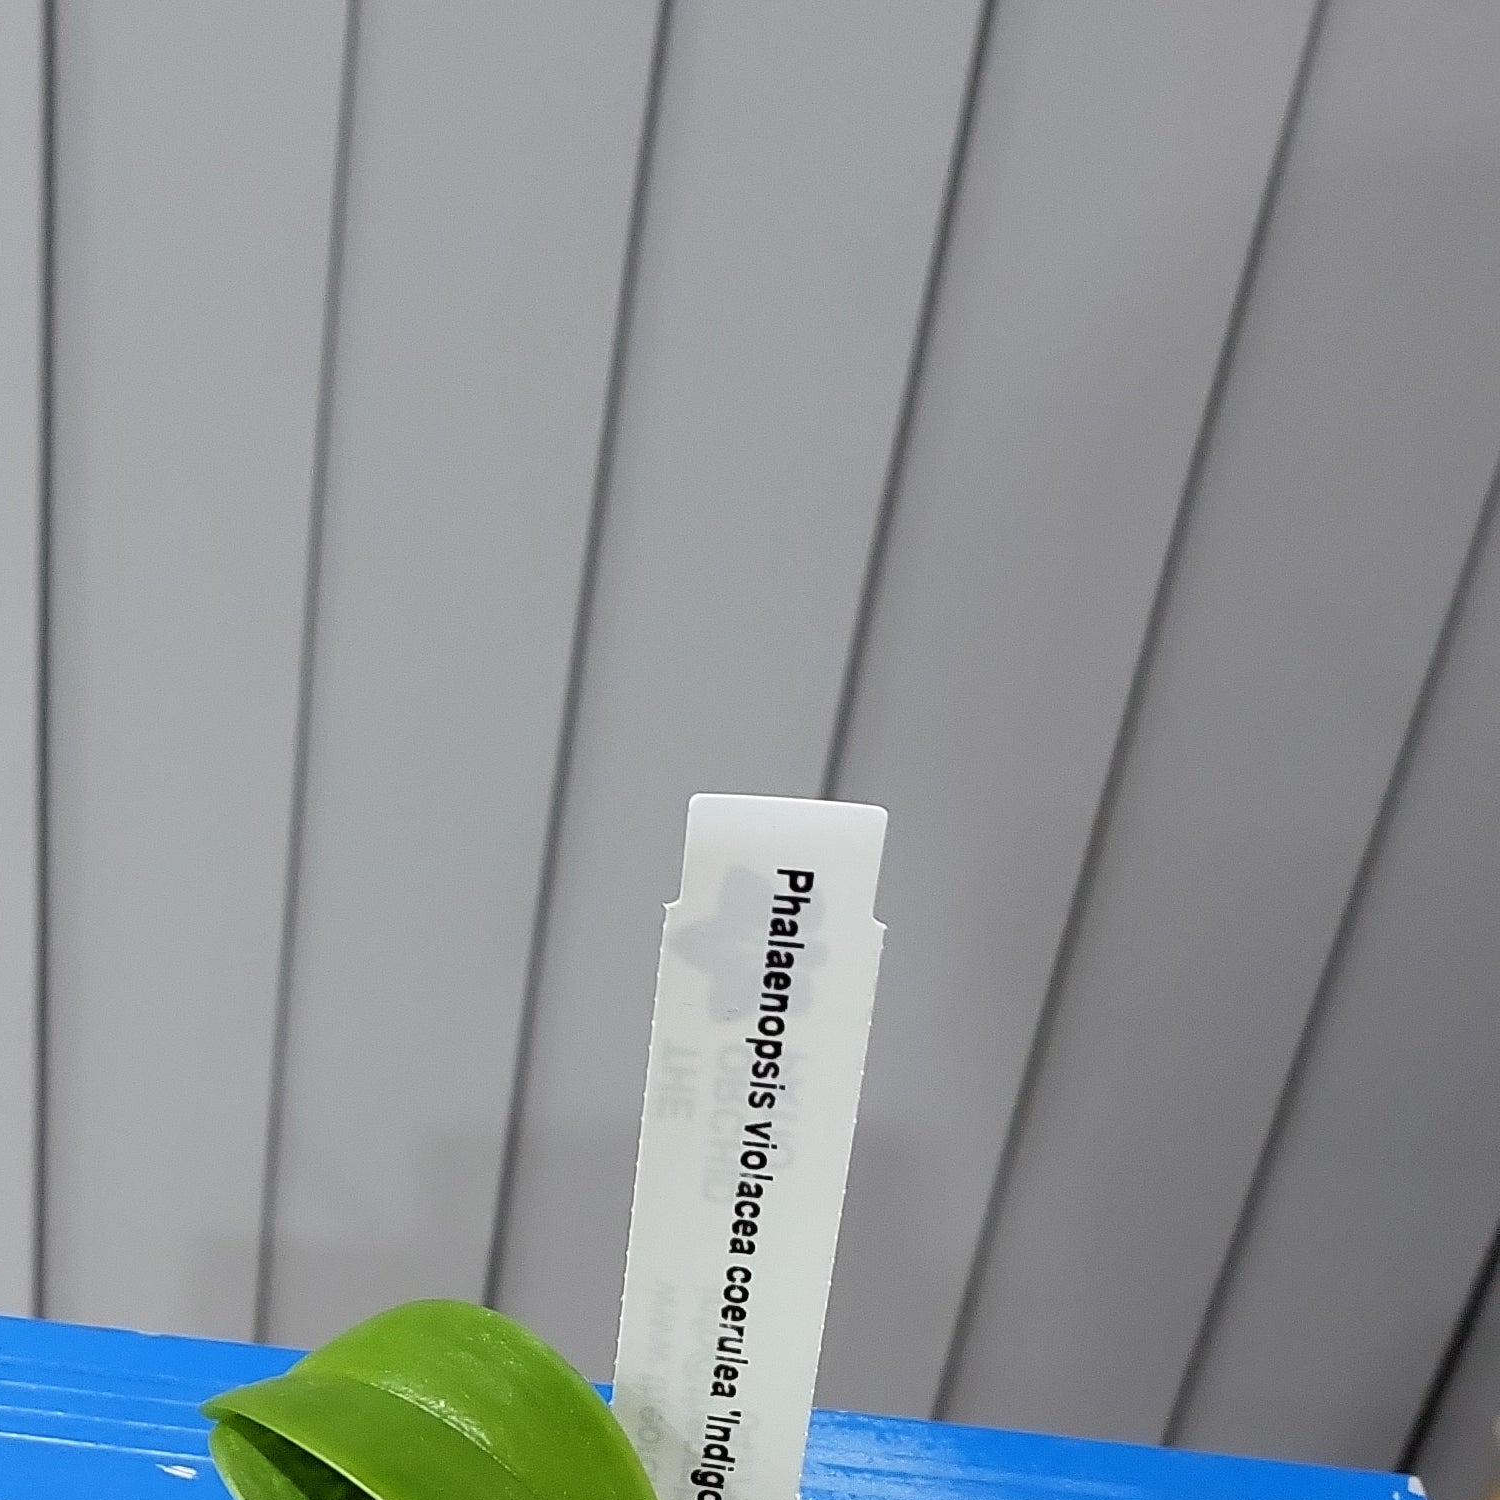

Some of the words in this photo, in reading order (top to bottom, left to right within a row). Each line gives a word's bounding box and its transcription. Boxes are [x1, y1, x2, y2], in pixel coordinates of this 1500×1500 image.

[744, 869, 815, 1109] Phalaenopsis
[730, 1121, 778, 1255] violacea
[710, 1266, 749, 1398] coerulea
